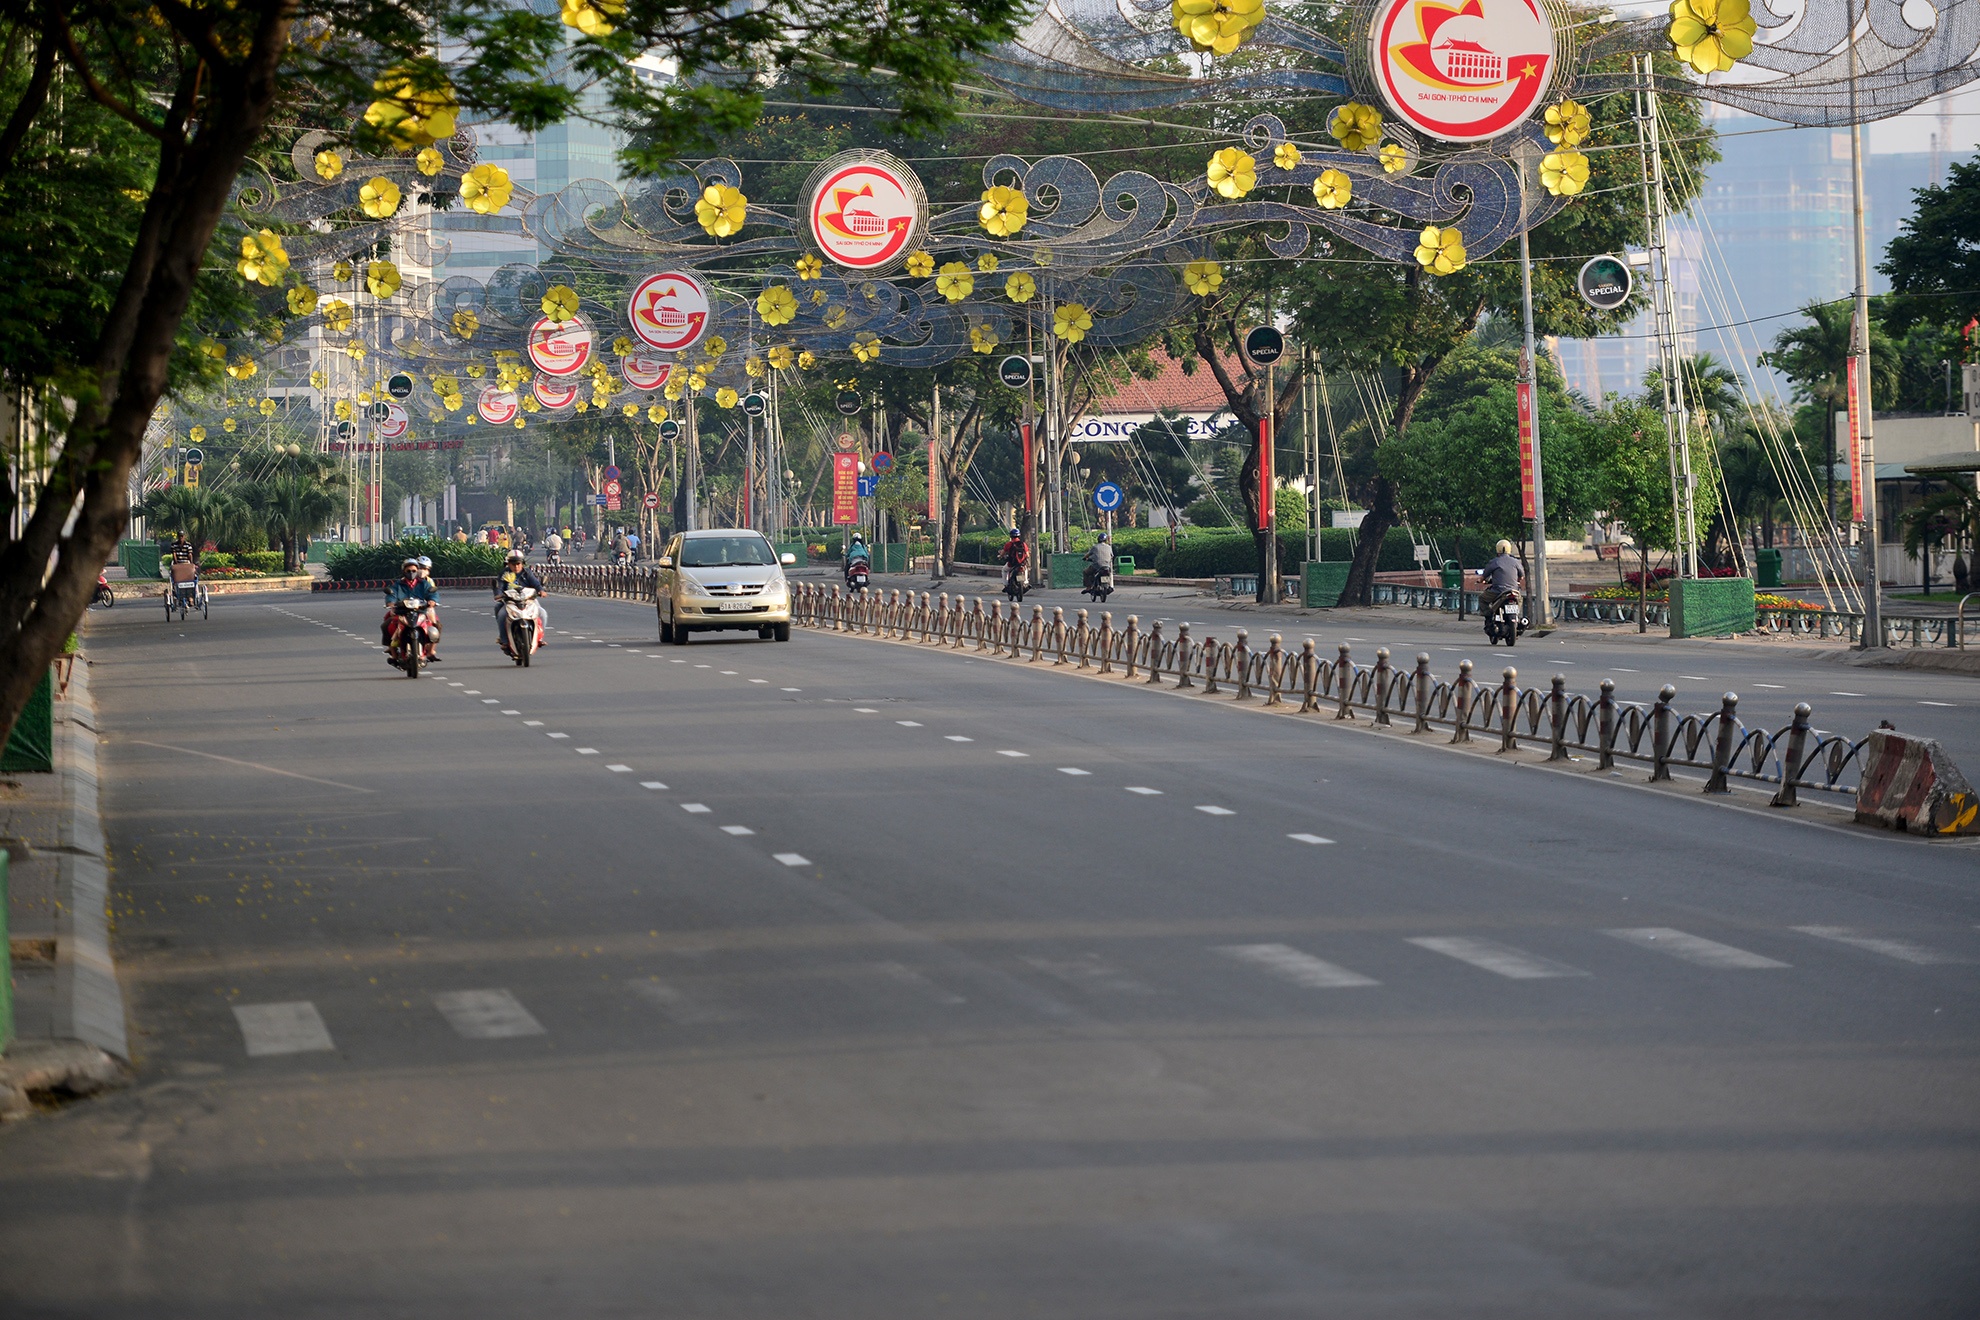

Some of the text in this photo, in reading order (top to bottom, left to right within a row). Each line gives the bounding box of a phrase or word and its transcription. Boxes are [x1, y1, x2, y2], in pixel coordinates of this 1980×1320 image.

[1589, 286, 1624, 296] SPECIAL
[1251, 348, 1279, 356] SPECIAL
[1070, 418, 1138, 437] CÔNG
